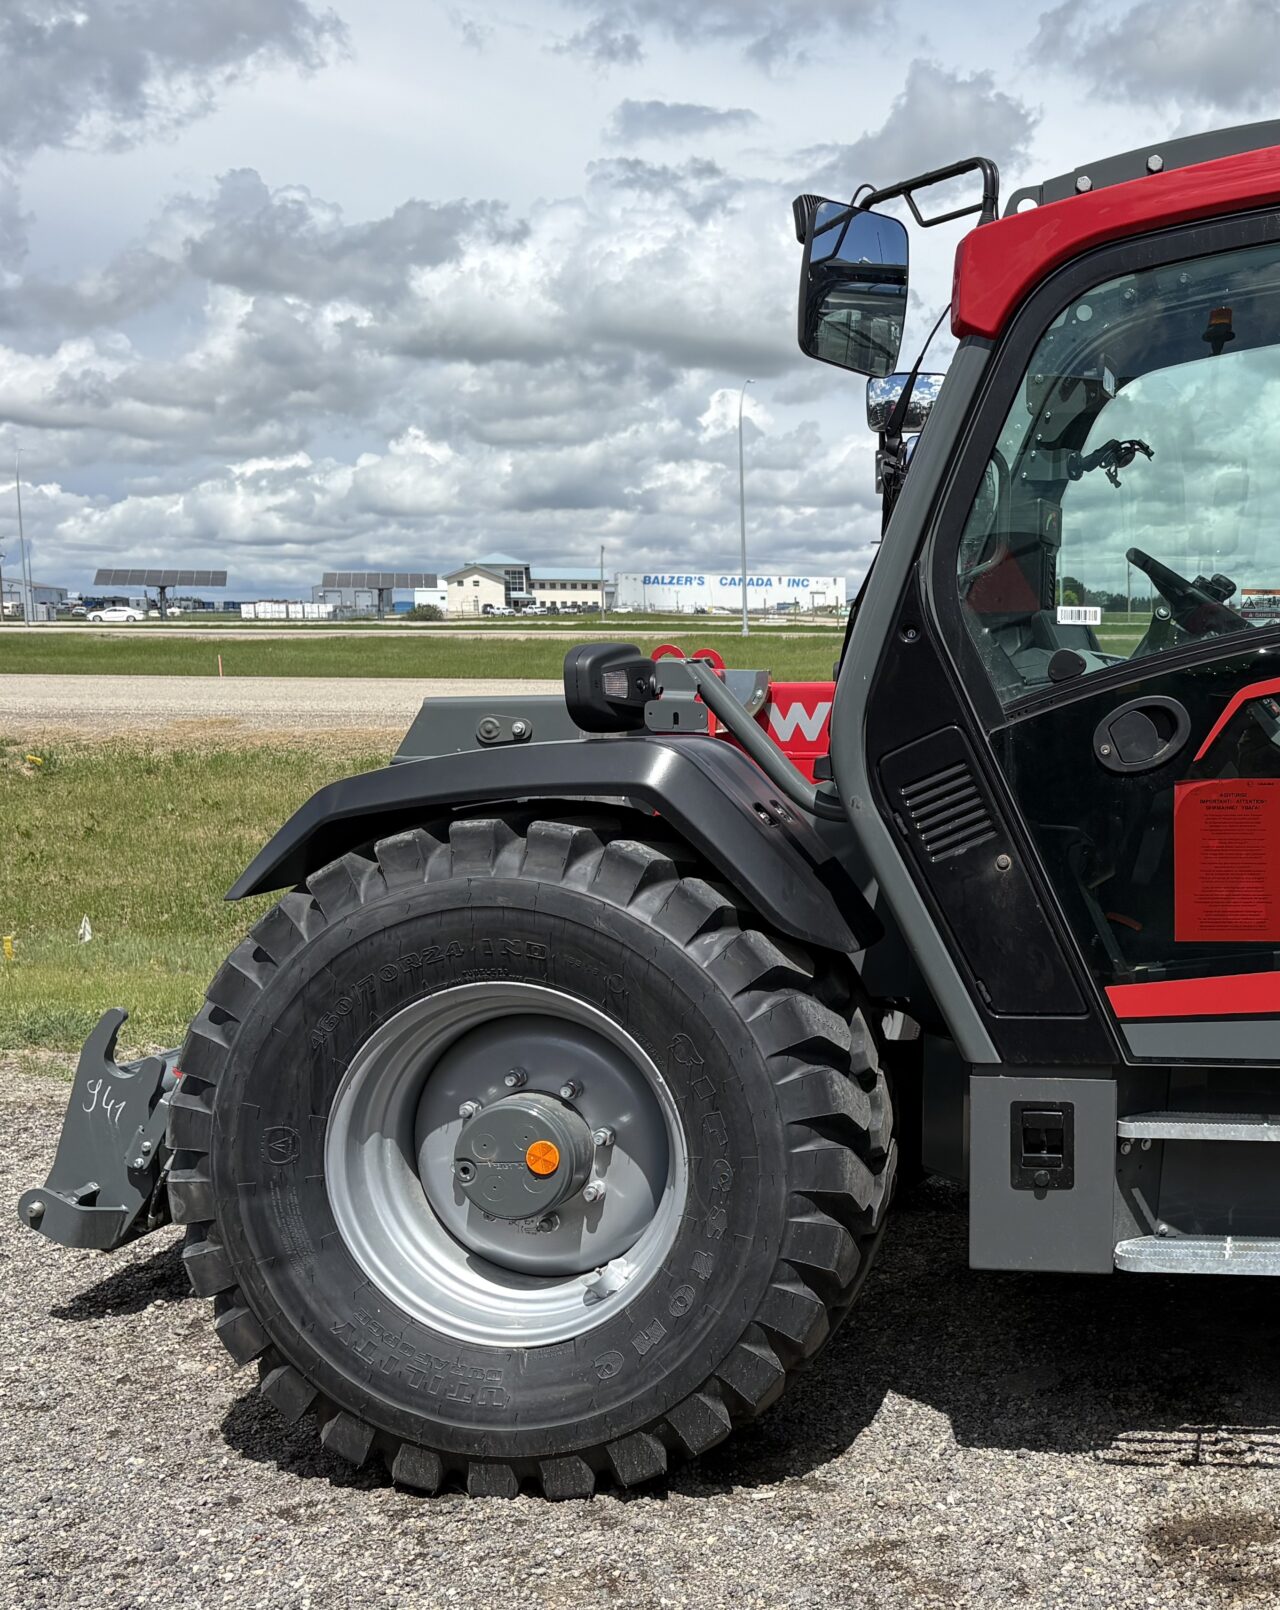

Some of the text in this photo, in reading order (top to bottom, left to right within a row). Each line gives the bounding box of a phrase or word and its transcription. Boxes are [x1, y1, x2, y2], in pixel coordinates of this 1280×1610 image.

[642, 575, 705, 586] BALZER'S
[787, 577, 810, 588] INC
[309, 939, 465, 1050] 460/70R24
[329, 1321, 509, 1408] UTILITY
[352, 1307, 504, 1382] DURAFORCE
